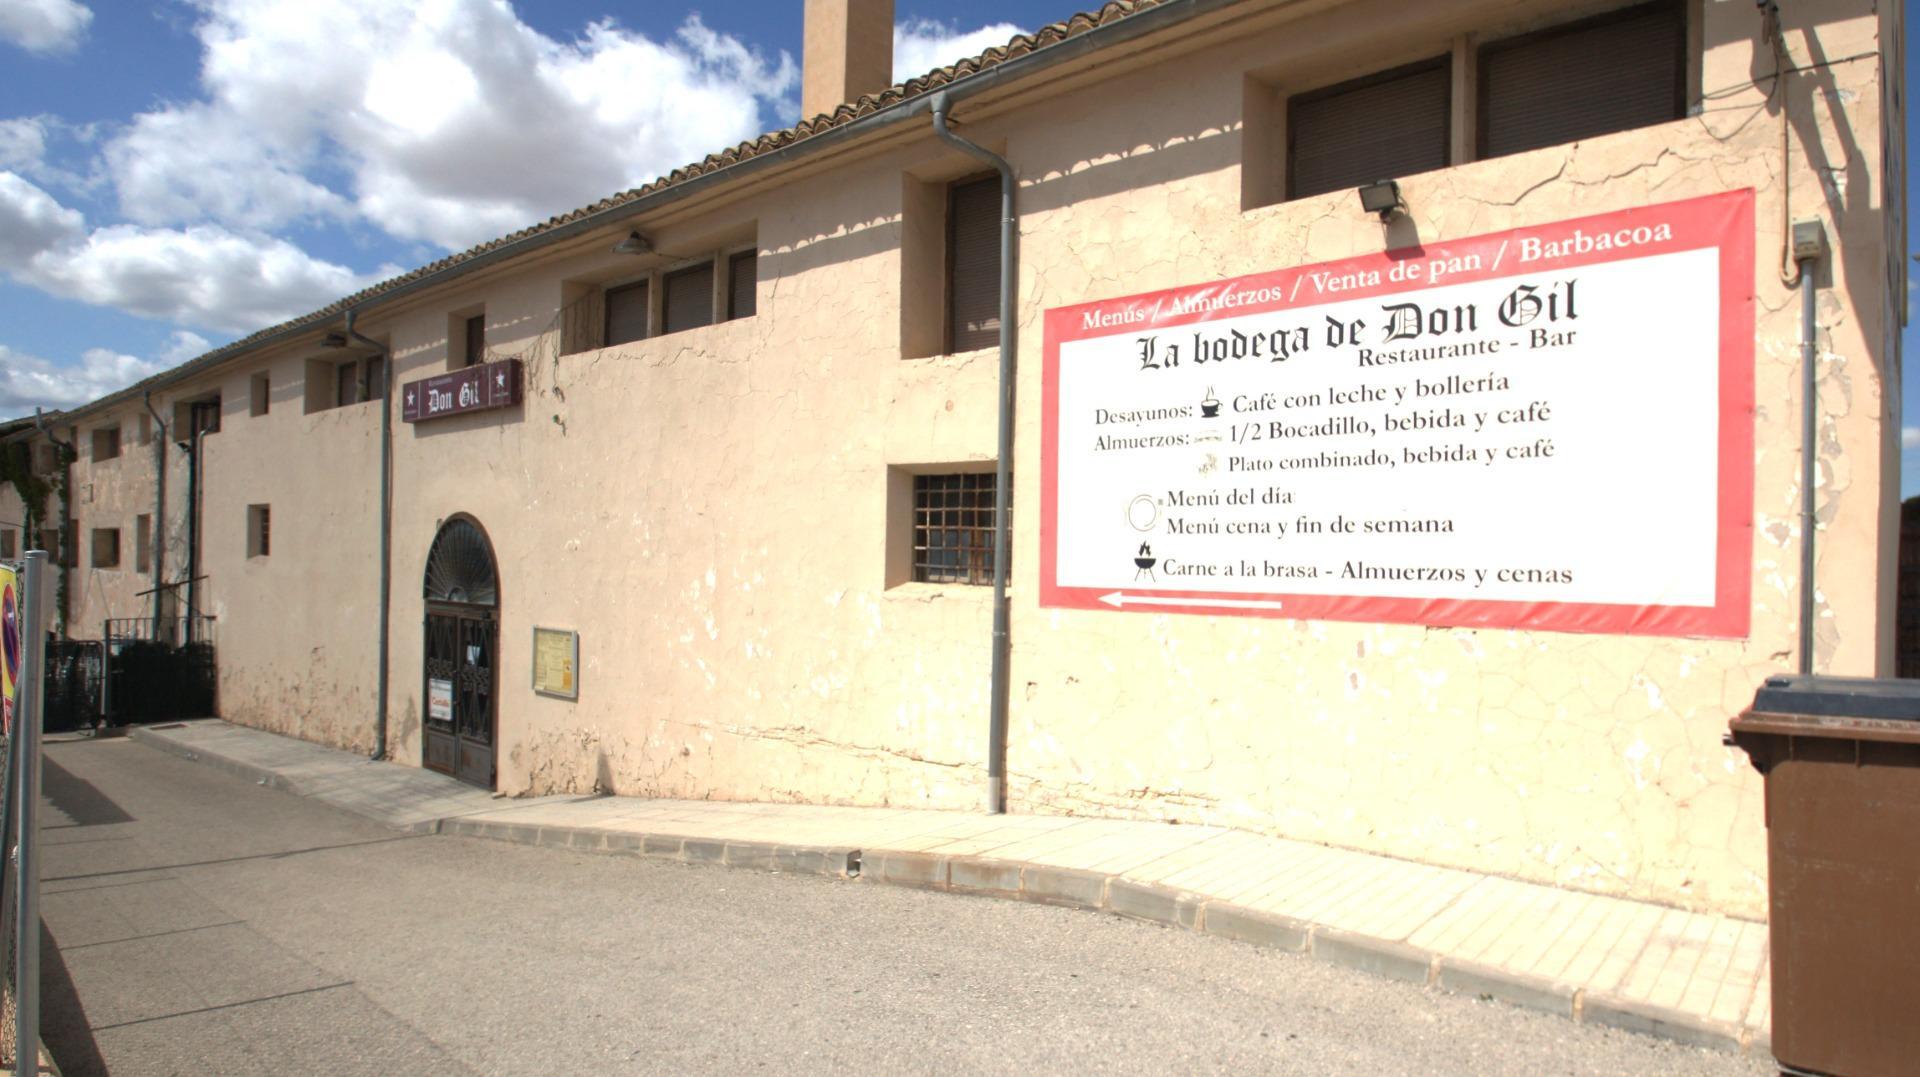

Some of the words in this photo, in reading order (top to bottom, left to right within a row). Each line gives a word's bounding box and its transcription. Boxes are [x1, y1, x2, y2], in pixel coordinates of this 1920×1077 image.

[1081, 305, 1145, 330] Menús
[1151, 299, 1163, 322] /
[1166, 282, 1282, 316] Almuerzos
[1289, 274, 1304, 303] /
[1310, 266, 1380, 294] Venta
[1389, 259, 1421, 283] de
[1428, 253, 1482, 283] pan
[1491, 239, 1509, 272] /
[1519, 222, 1673, 263] Barbacoa
[1136, 334, 1180, 372] La
[1192, 323, 1310, 364] bodega
[1326, 314, 1367, 349] de
[1381, 302, 1479, 344] Don
[1497, 277, 1580, 328] Gil
[1358, 336, 1501, 367] Restaurante
[1529, 328, 1577, 350] Bar
[428, 389, 452, 413] Don
[458, 380, 480, 408] Gil
[1095, 405, 1193, 427] Desayunos:
[1232, 393, 1277, 413] Café
[1283, 393, 1321, 413] con
[1329, 384, 1388, 405] leche
[1394, 386, 1407, 406] y
[1415, 372, 1510, 398] bollería
[1095, 433, 1190, 451] Almuerzos:
[1229, 422, 1262, 445] 1/2
[1269, 415, 1377, 440] Bocadillo,
[1384, 408, 1467, 432] bebida
[1474, 411, 1488, 432] y
[1497, 400, 1552, 424] café
[1229, 455, 1273, 472] Plato
[1279, 449, 1396, 470] combinado,
[1403, 443, 1477, 464] bebida
[1485, 448, 1498, 466] y
[1505, 438, 1556, 460] café
[1167, 489, 1219, 507] Menú
[1226, 487, 1255, 505] del
[1167, 517, 1219, 534] Menú
[1226, 519, 1271, 534] cena
[1278, 521, 1289, 539] y
[1296, 515, 1323, 533] fin
[1330, 515, 1356, 533] de
[1363, 518, 1455, 534] semana
[1163, 558, 1218, 576] Carne
[1224, 563, 1234, 577] a
[1240, 559, 1257, 577] la
[1264, 560, 1319, 578] brasa
[1340, 560, 1466, 581] Almuerzos
[1474, 568, 1488, 588] y
[1496, 567, 1574, 584] cenas
